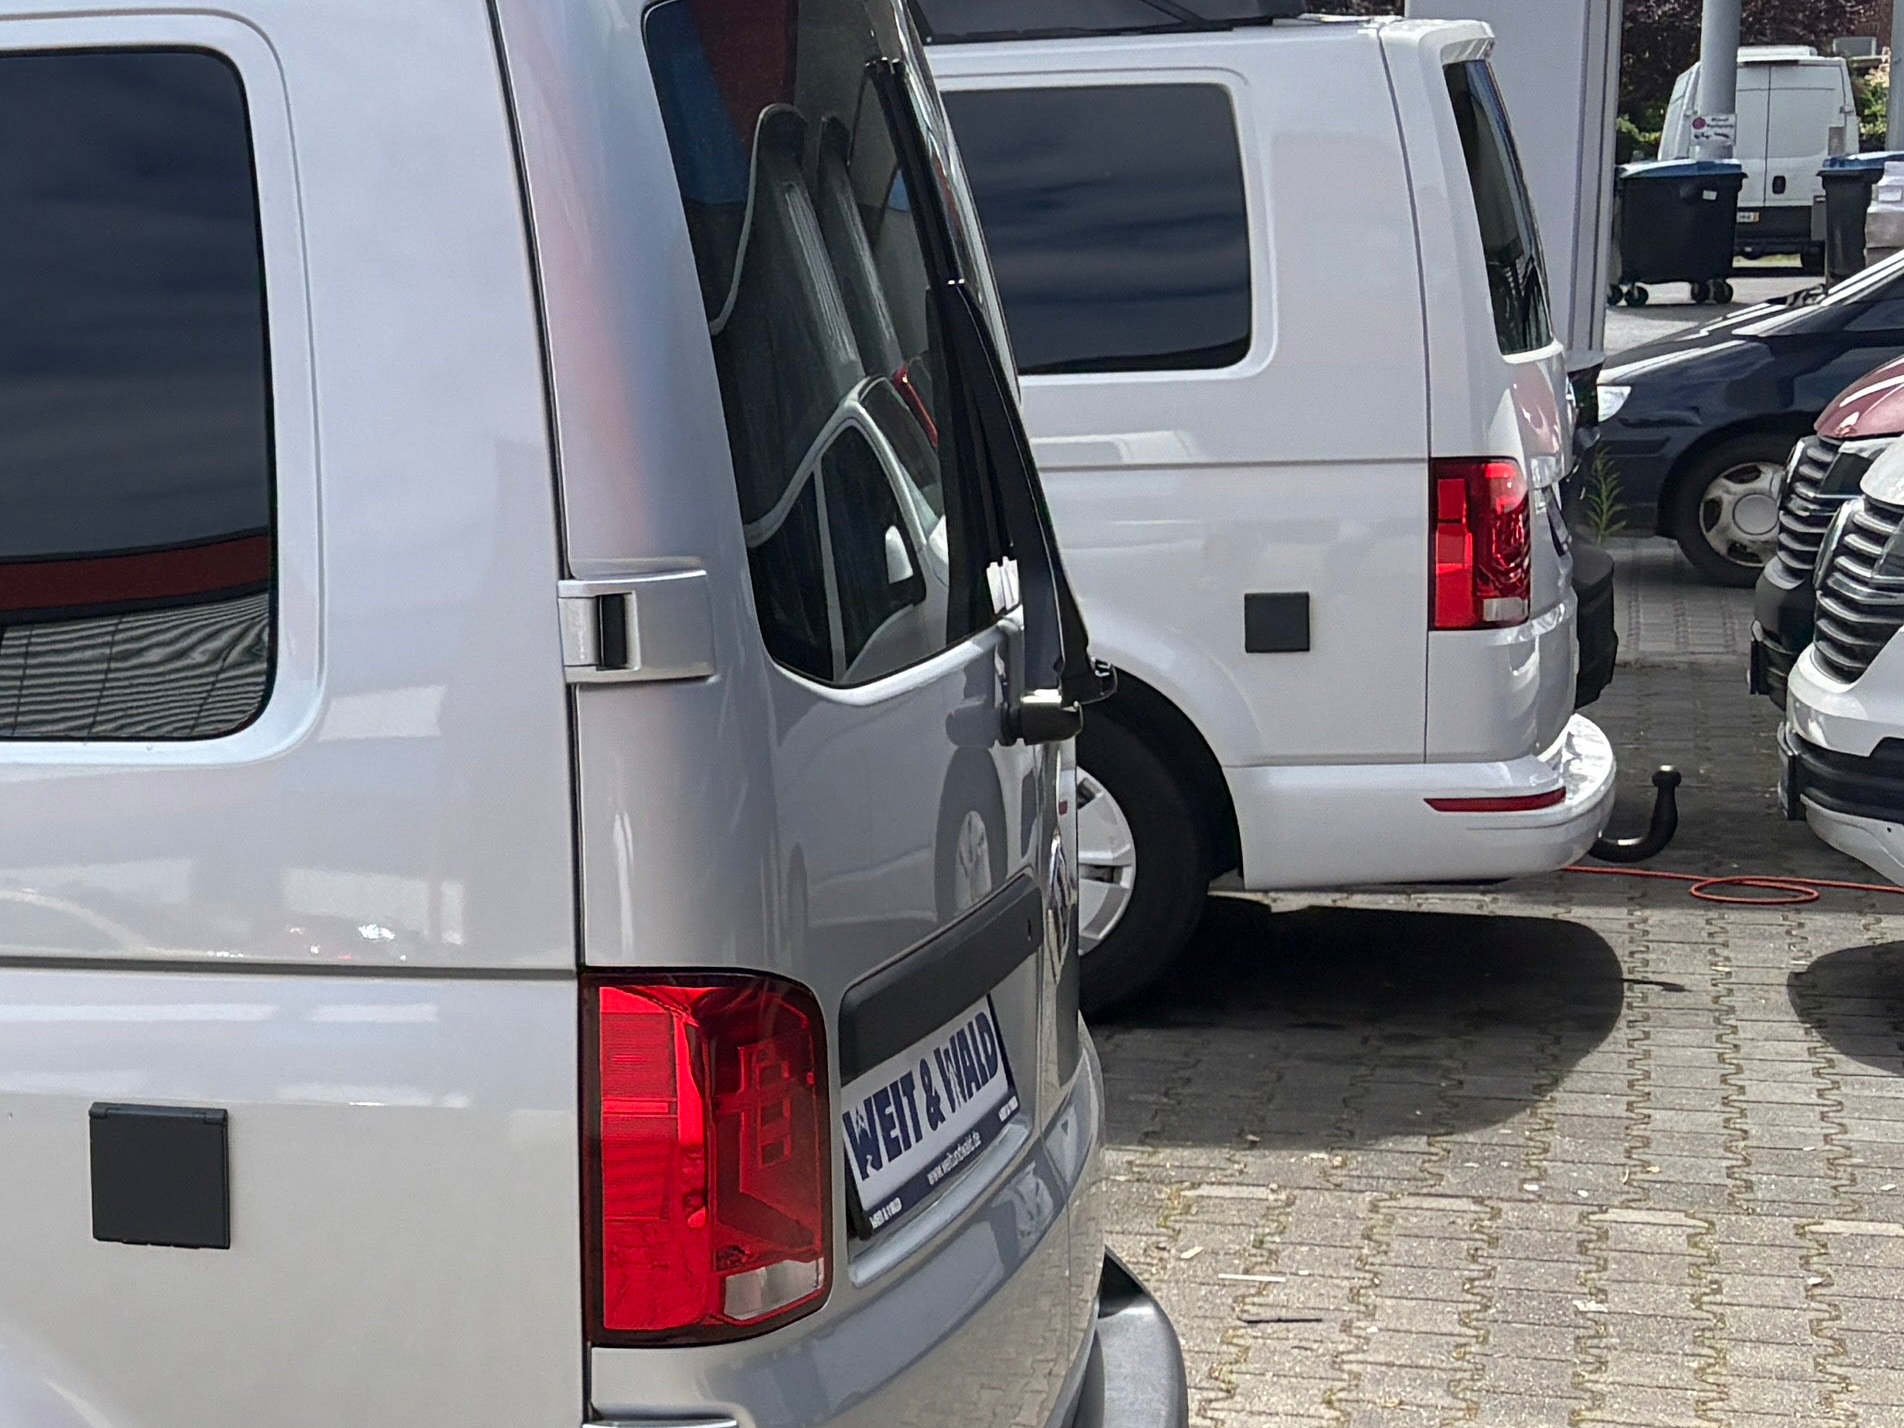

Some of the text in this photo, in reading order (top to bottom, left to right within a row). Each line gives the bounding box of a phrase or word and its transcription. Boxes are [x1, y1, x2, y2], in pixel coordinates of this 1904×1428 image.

[842, 1011, 999, 1182] WEIT & WALD
